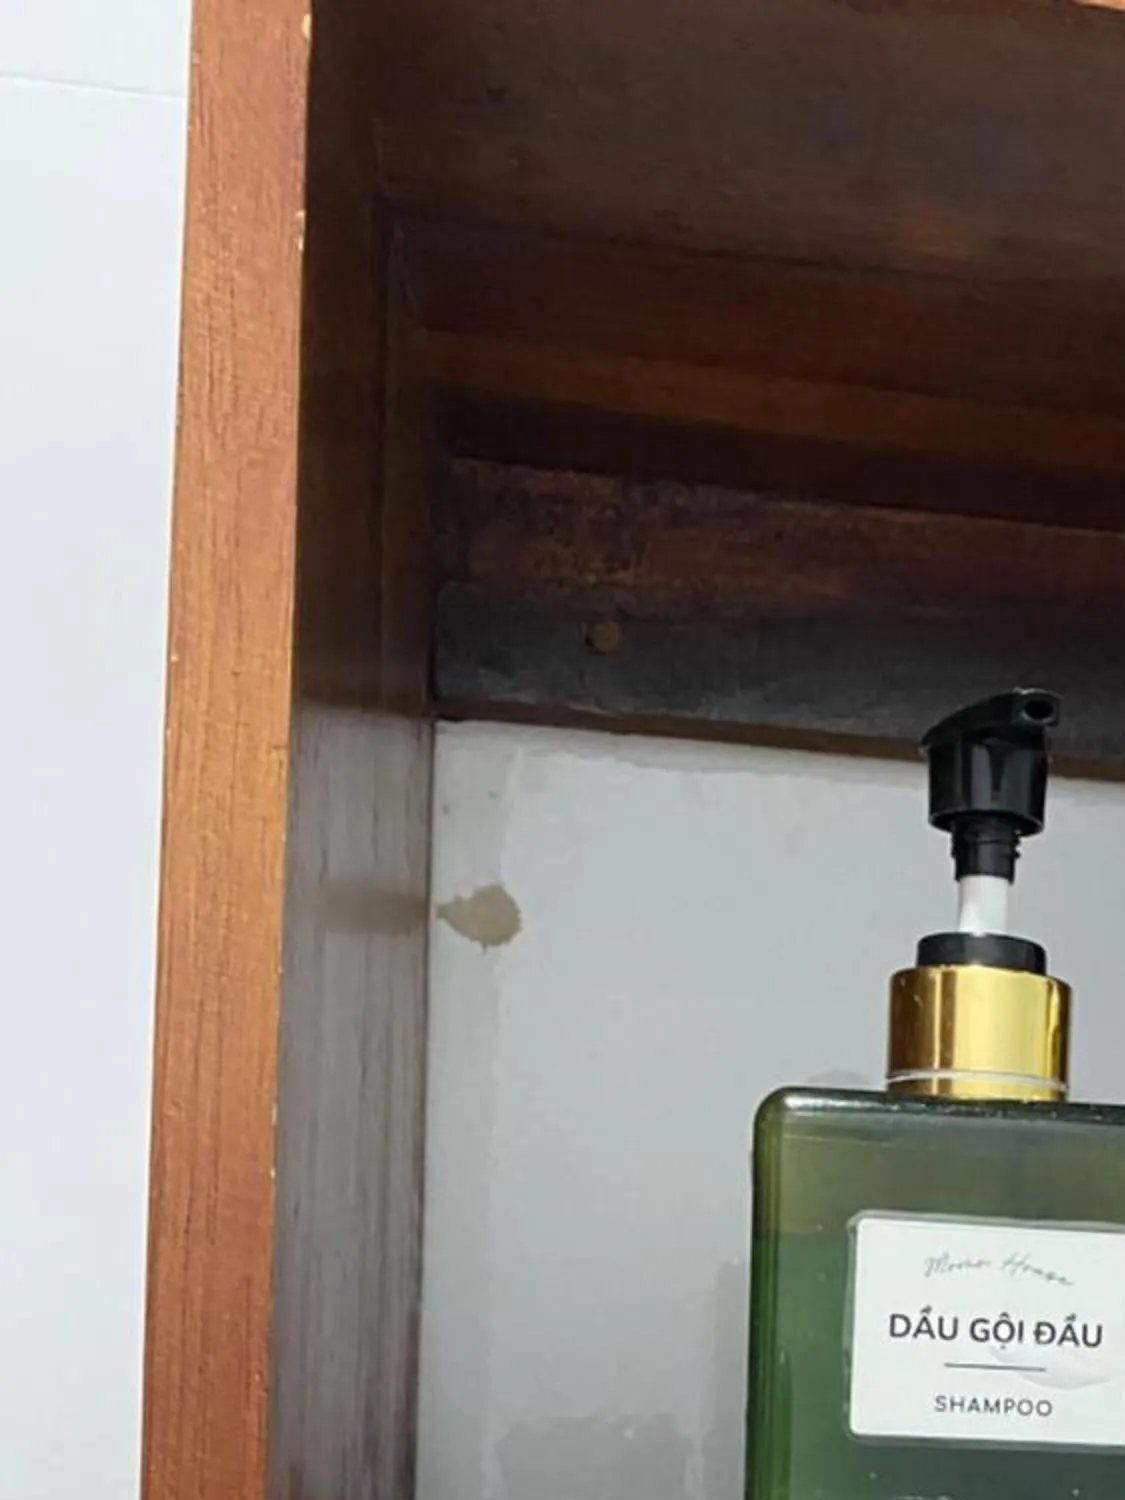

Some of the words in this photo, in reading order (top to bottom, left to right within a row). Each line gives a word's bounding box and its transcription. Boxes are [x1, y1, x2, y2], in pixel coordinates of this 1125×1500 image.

[969, 1312, 1024, 1350] GỘI
[1033, 1313, 1103, 1348] ĐẦU
[933, 1395, 1054, 1417] SHAMPOO
